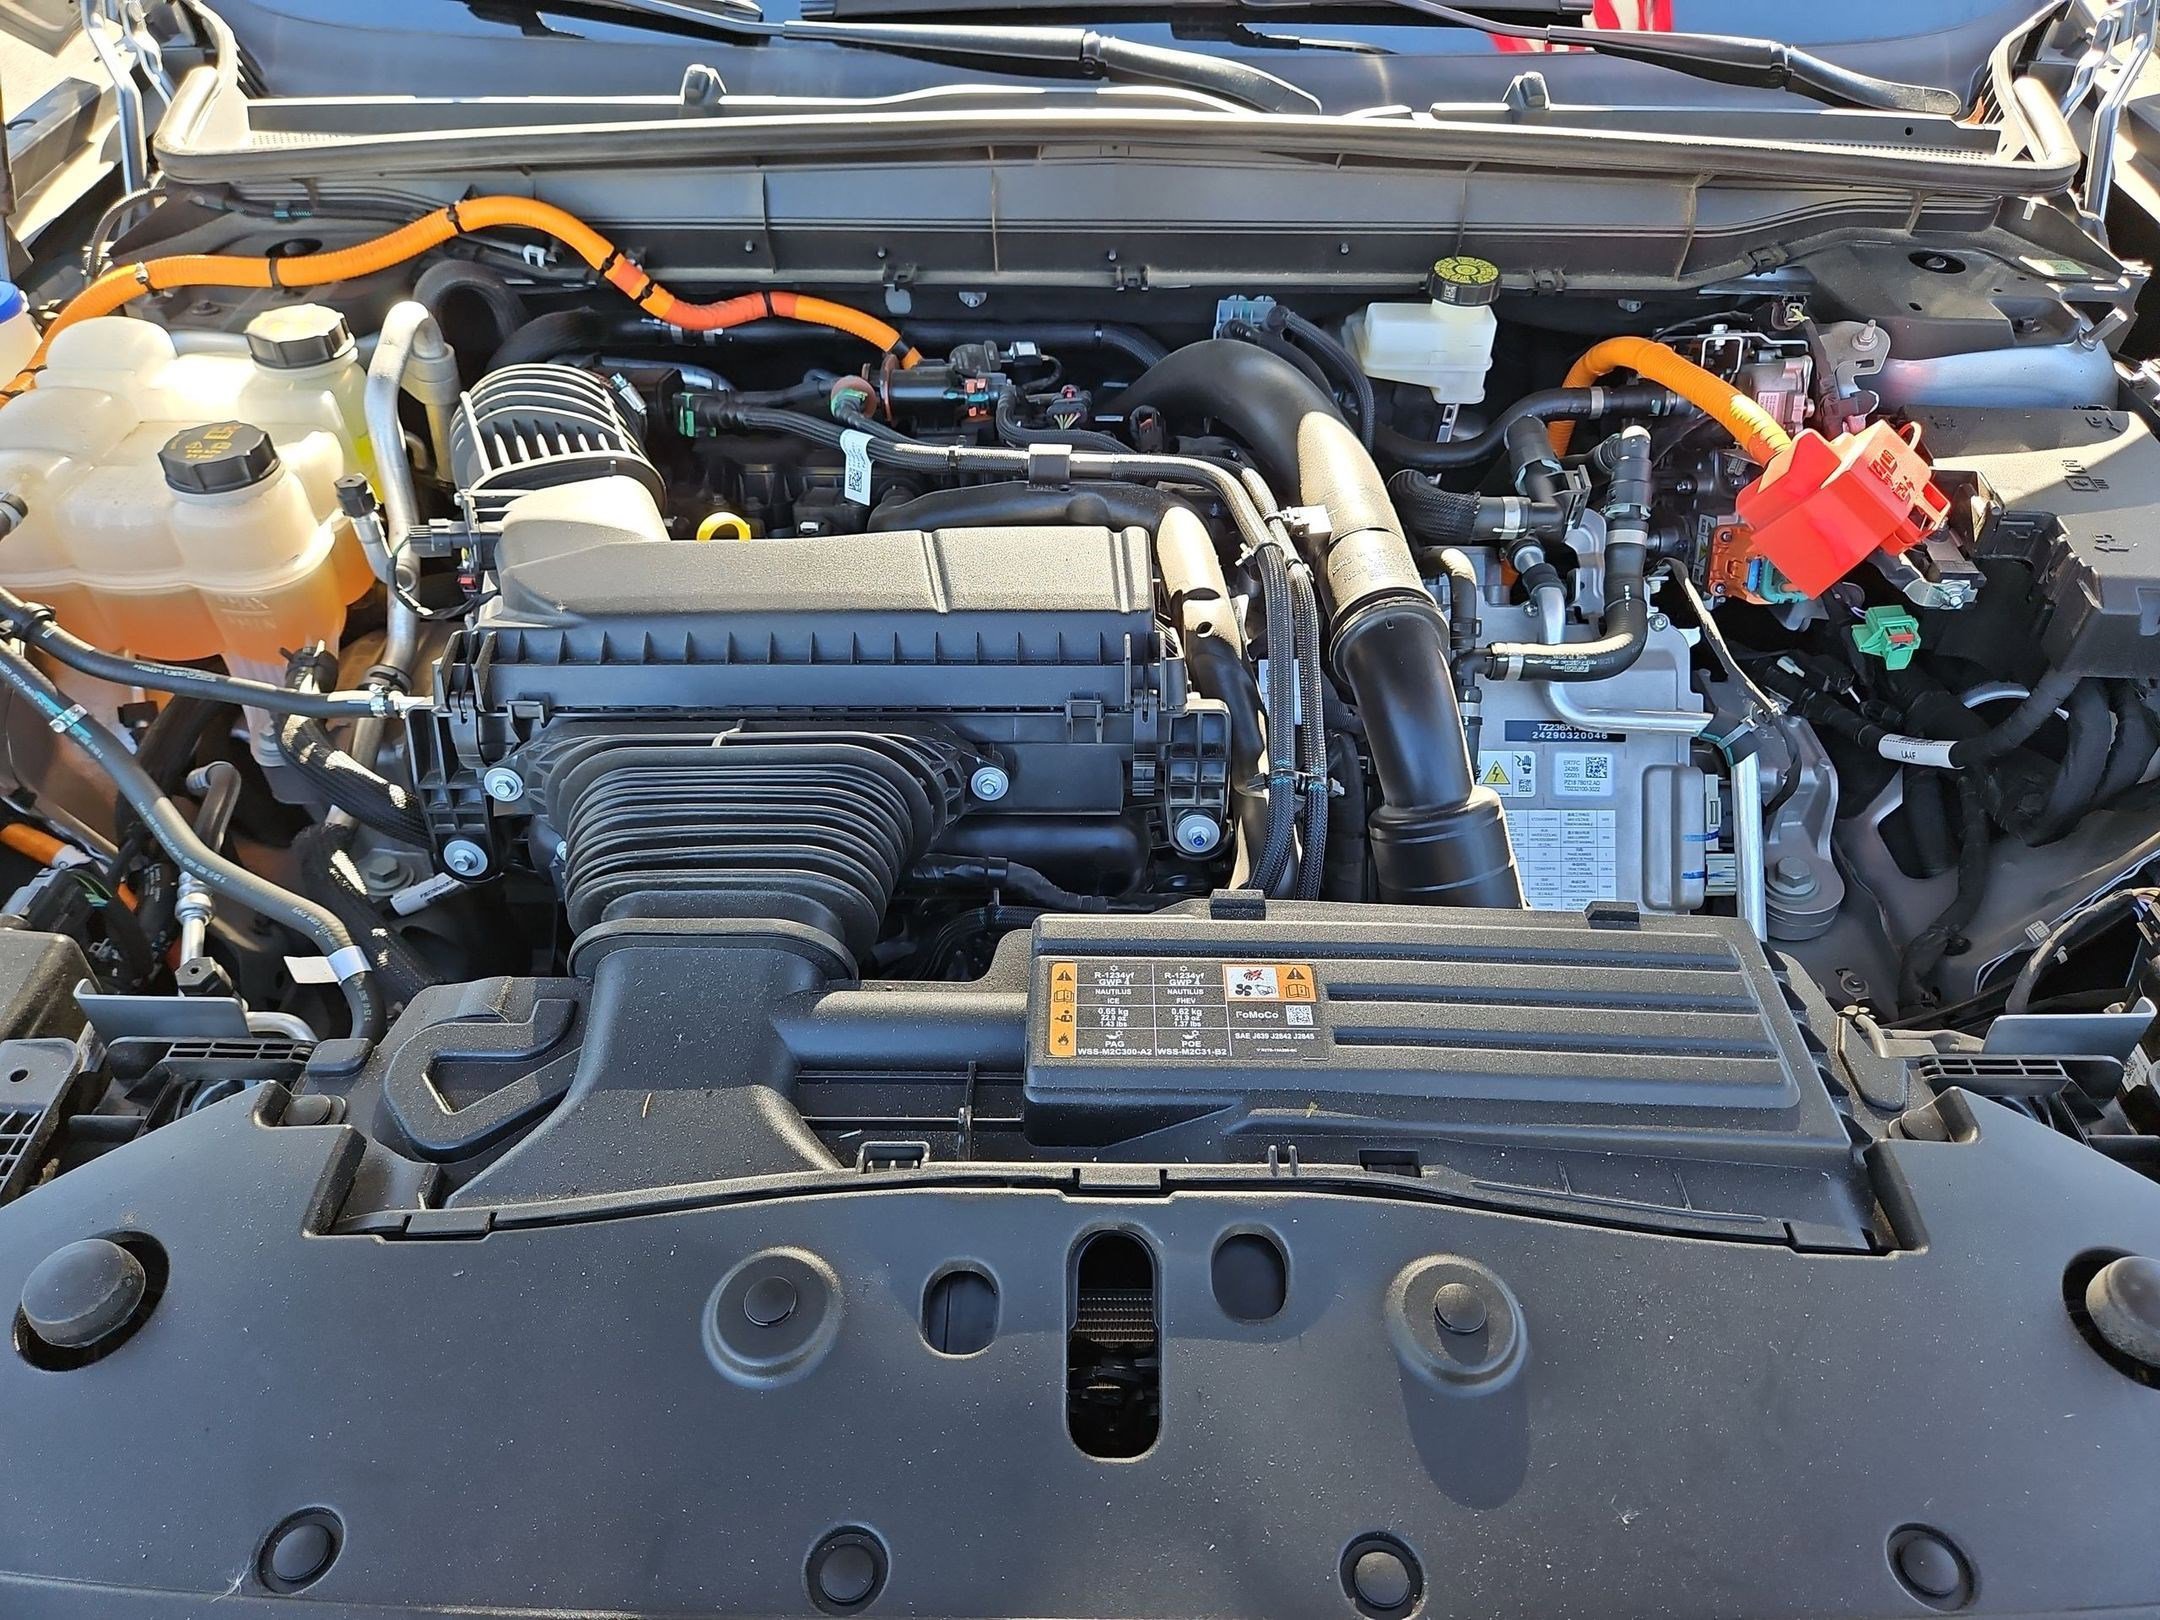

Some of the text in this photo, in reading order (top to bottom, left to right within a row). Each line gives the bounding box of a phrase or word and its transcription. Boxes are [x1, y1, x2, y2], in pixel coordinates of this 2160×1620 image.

[1164, 972, 1204, 980] R-1234yf
[1118, 1008, 1129, 1016] kg
[1191, 1008, 1202, 1016] kg
[1235, 1011, 1279, 1019] FoMoCo
